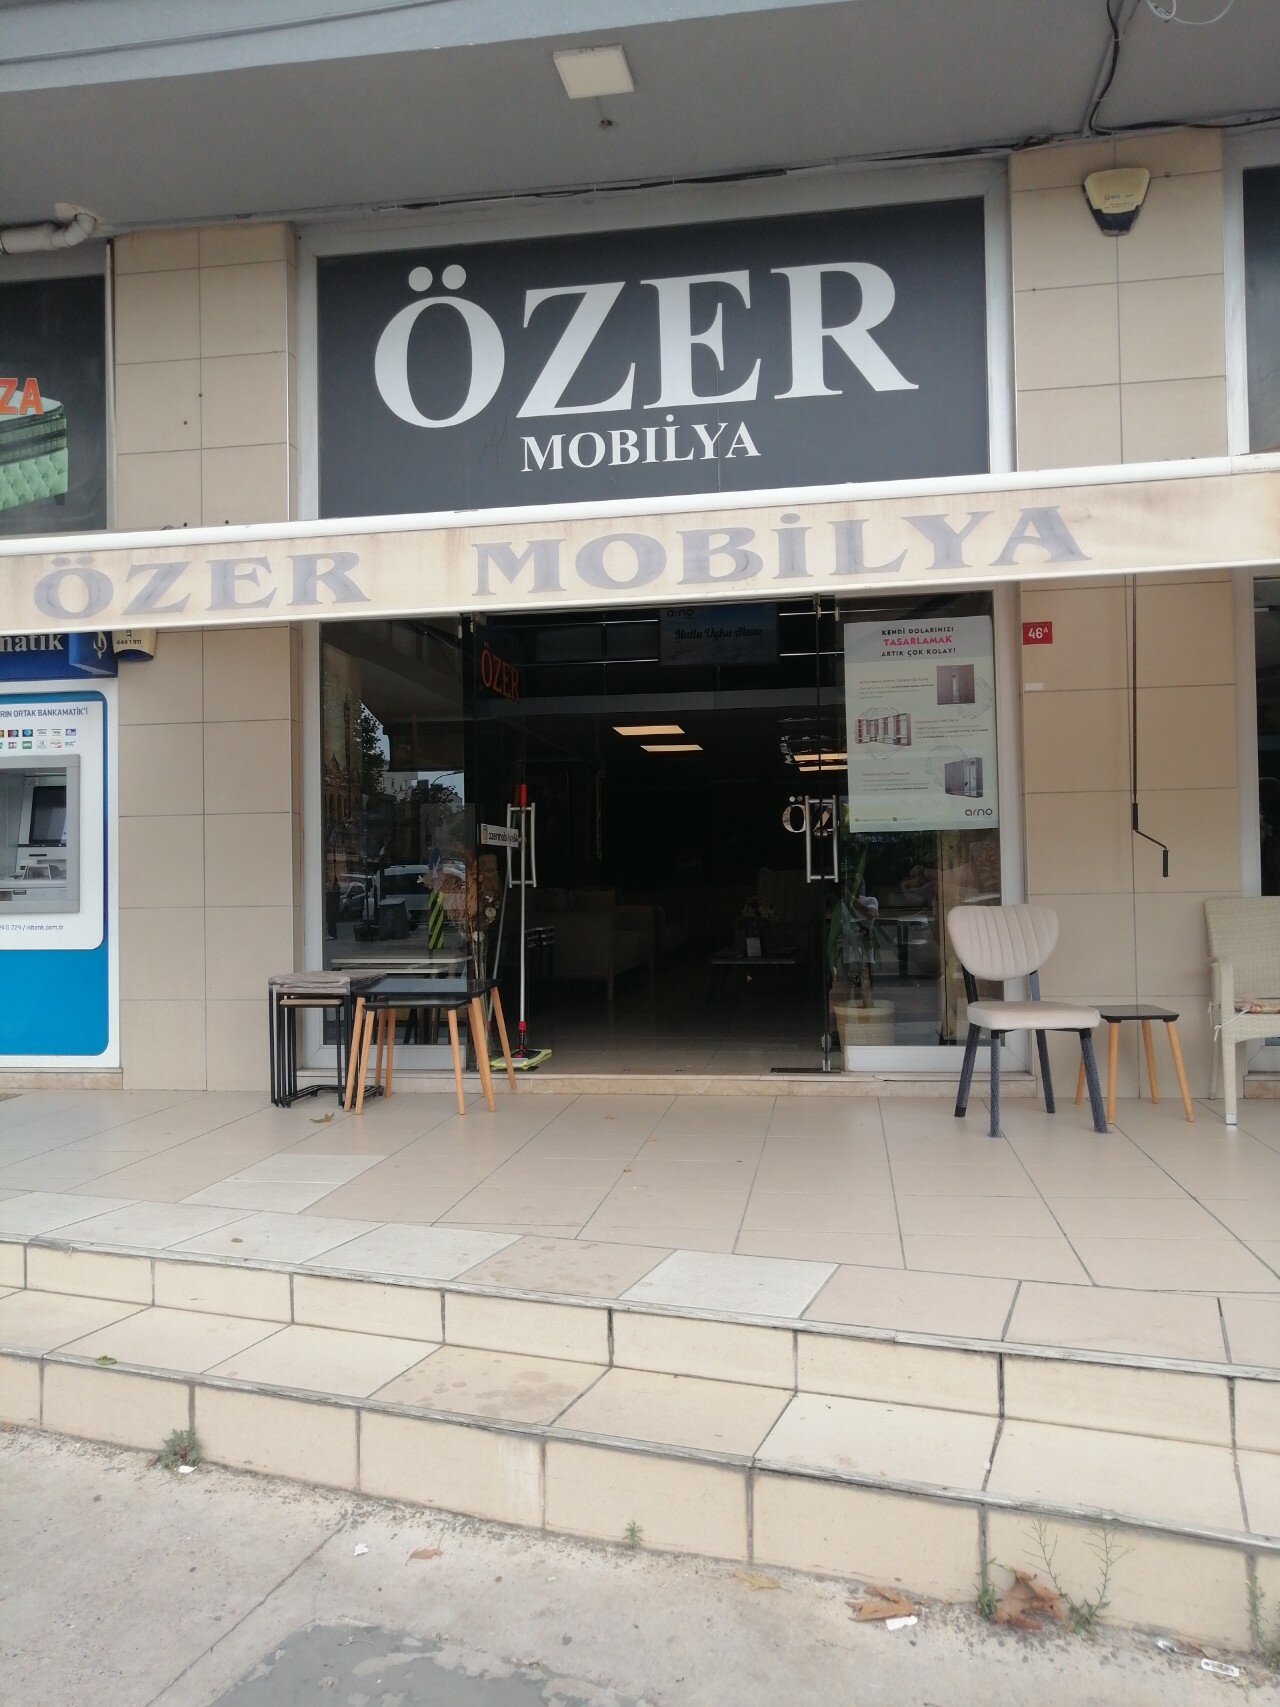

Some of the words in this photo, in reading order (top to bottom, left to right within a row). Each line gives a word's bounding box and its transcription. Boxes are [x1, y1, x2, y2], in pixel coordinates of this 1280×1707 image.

[374, 262, 919, 429] ÖZER
[520, 414, 761, 472] MOBİLYA
[34, 551, 371, 620] ÖZER
[472, 506, 1092, 597] MOBİLYA
[881, 628, 905, 636] KENDİ
[883, 635, 952, 647] TASARLAMAK
[907, 649, 923, 658] ÇOK
[481, 640, 520, 701] ÖZER
[14, 709, 36, 718] ORTAK
[964, 808, 993, 817] arno
